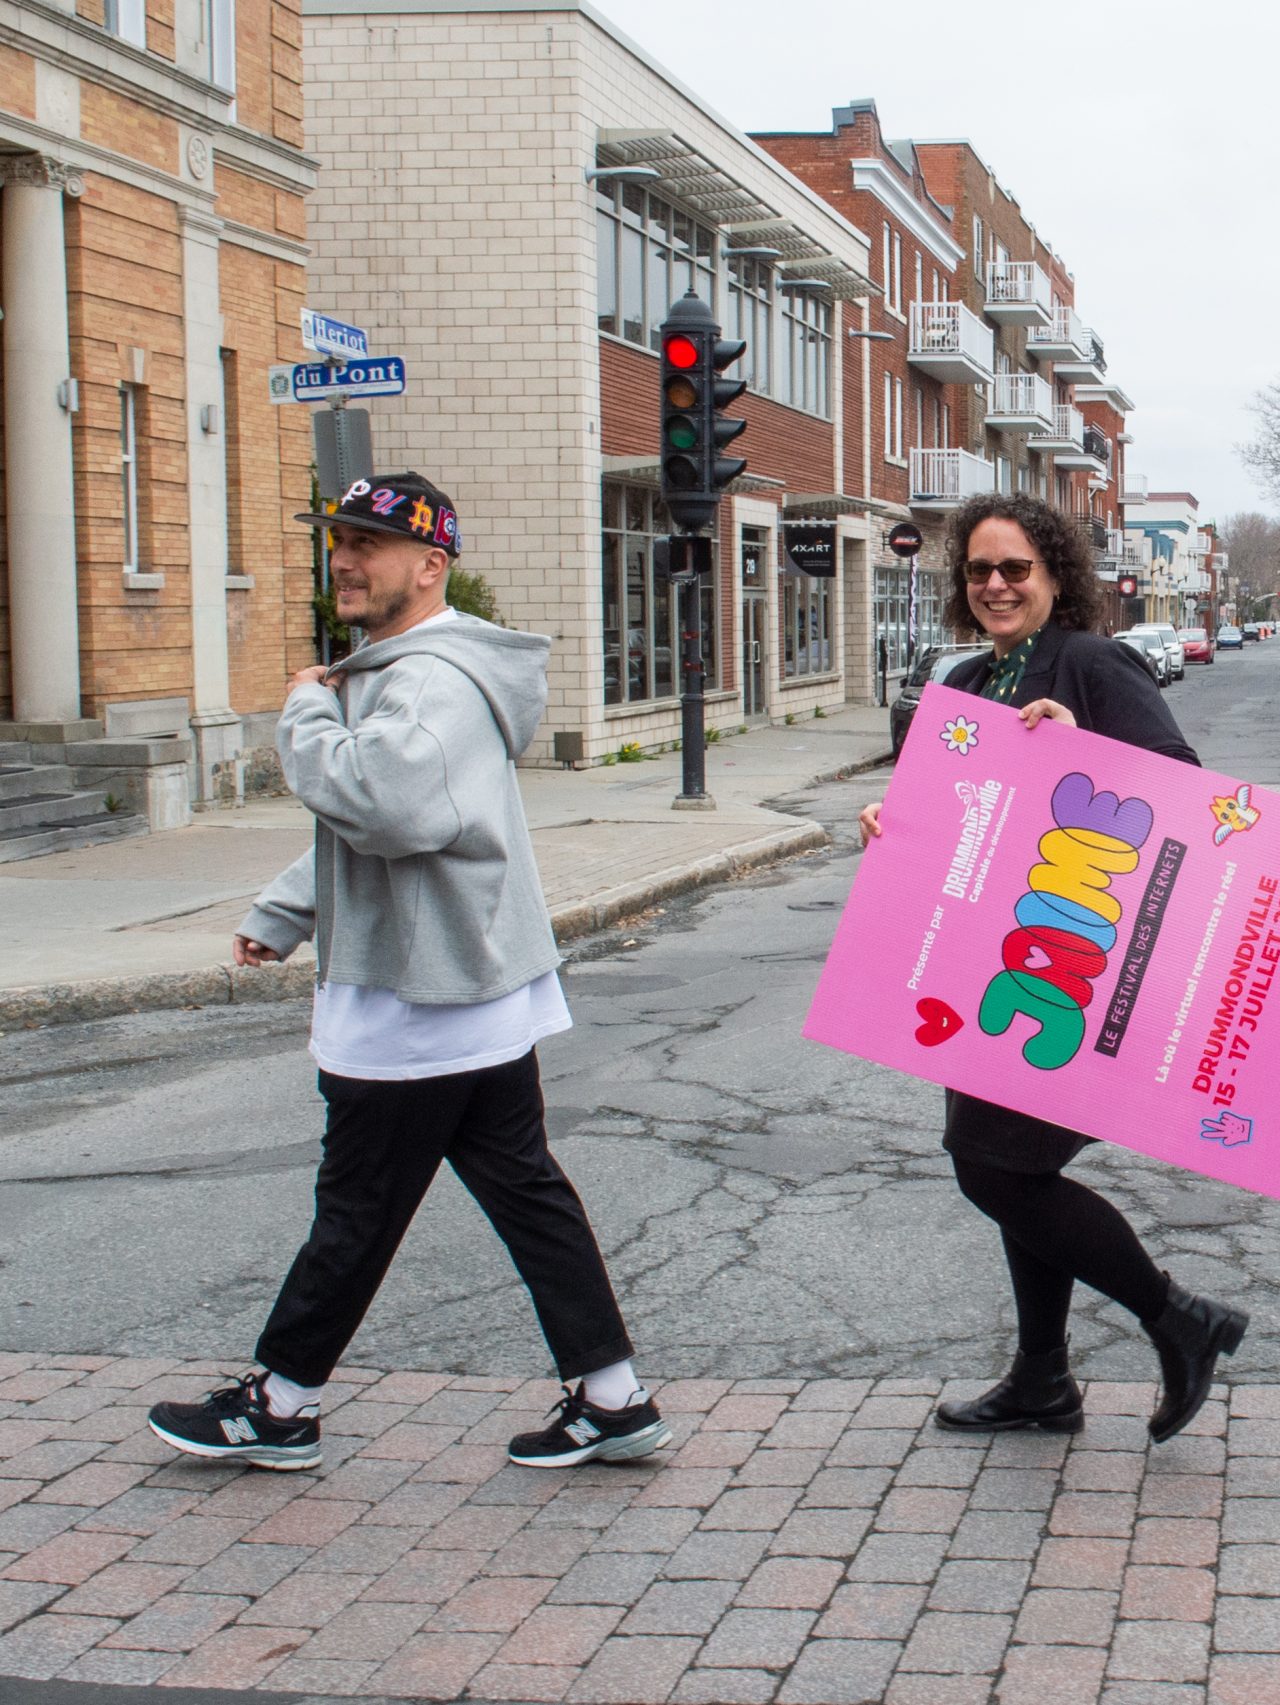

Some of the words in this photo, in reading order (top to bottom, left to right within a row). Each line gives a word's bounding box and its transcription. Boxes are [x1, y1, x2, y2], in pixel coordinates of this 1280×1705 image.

[314, 316, 365, 352] Heriot
[295, 367, 321, 386] du
[329, 361, 400, 385] Pont
[790, 543, 832, 553] AXART
[969, 858, 991, 902] Capitale
[987, 847, 995, 858] du
[991, 786, 1016, 846] développement
[1221, 861, 1237, 890] réel
[1213, 892, 1227, 906] le
[978, 772, 1154, 1070] JAIME
[907, 931, 936, 990] Présenté
[931, 904, 944, 929] par
[1103, 1030, 1119, 1048] LE
[1111, 956, 1143, 1024] FESTIVAL
[1136, 924, 1151, 951] DES
[1145, 844, 1180, 918] INTERNETS
[1192, 908, 1222, 977] rencontre
[1191, 875, 1278, 1094] DRUMMONDVILLE
[1175, 978, 1198, 1026] virtuel
[1168, 1029, 1182, 1043] le
[1163, 1045, 1176, 1063] où
[1213, 1081, 1236, 1106] 15
[1228, 1034, 1250, 1060] 17
[1155, 1066, 1170, 1083] Là
[220, 1416, 258, 1444] N
[564, 1417, 602, 1446] N
